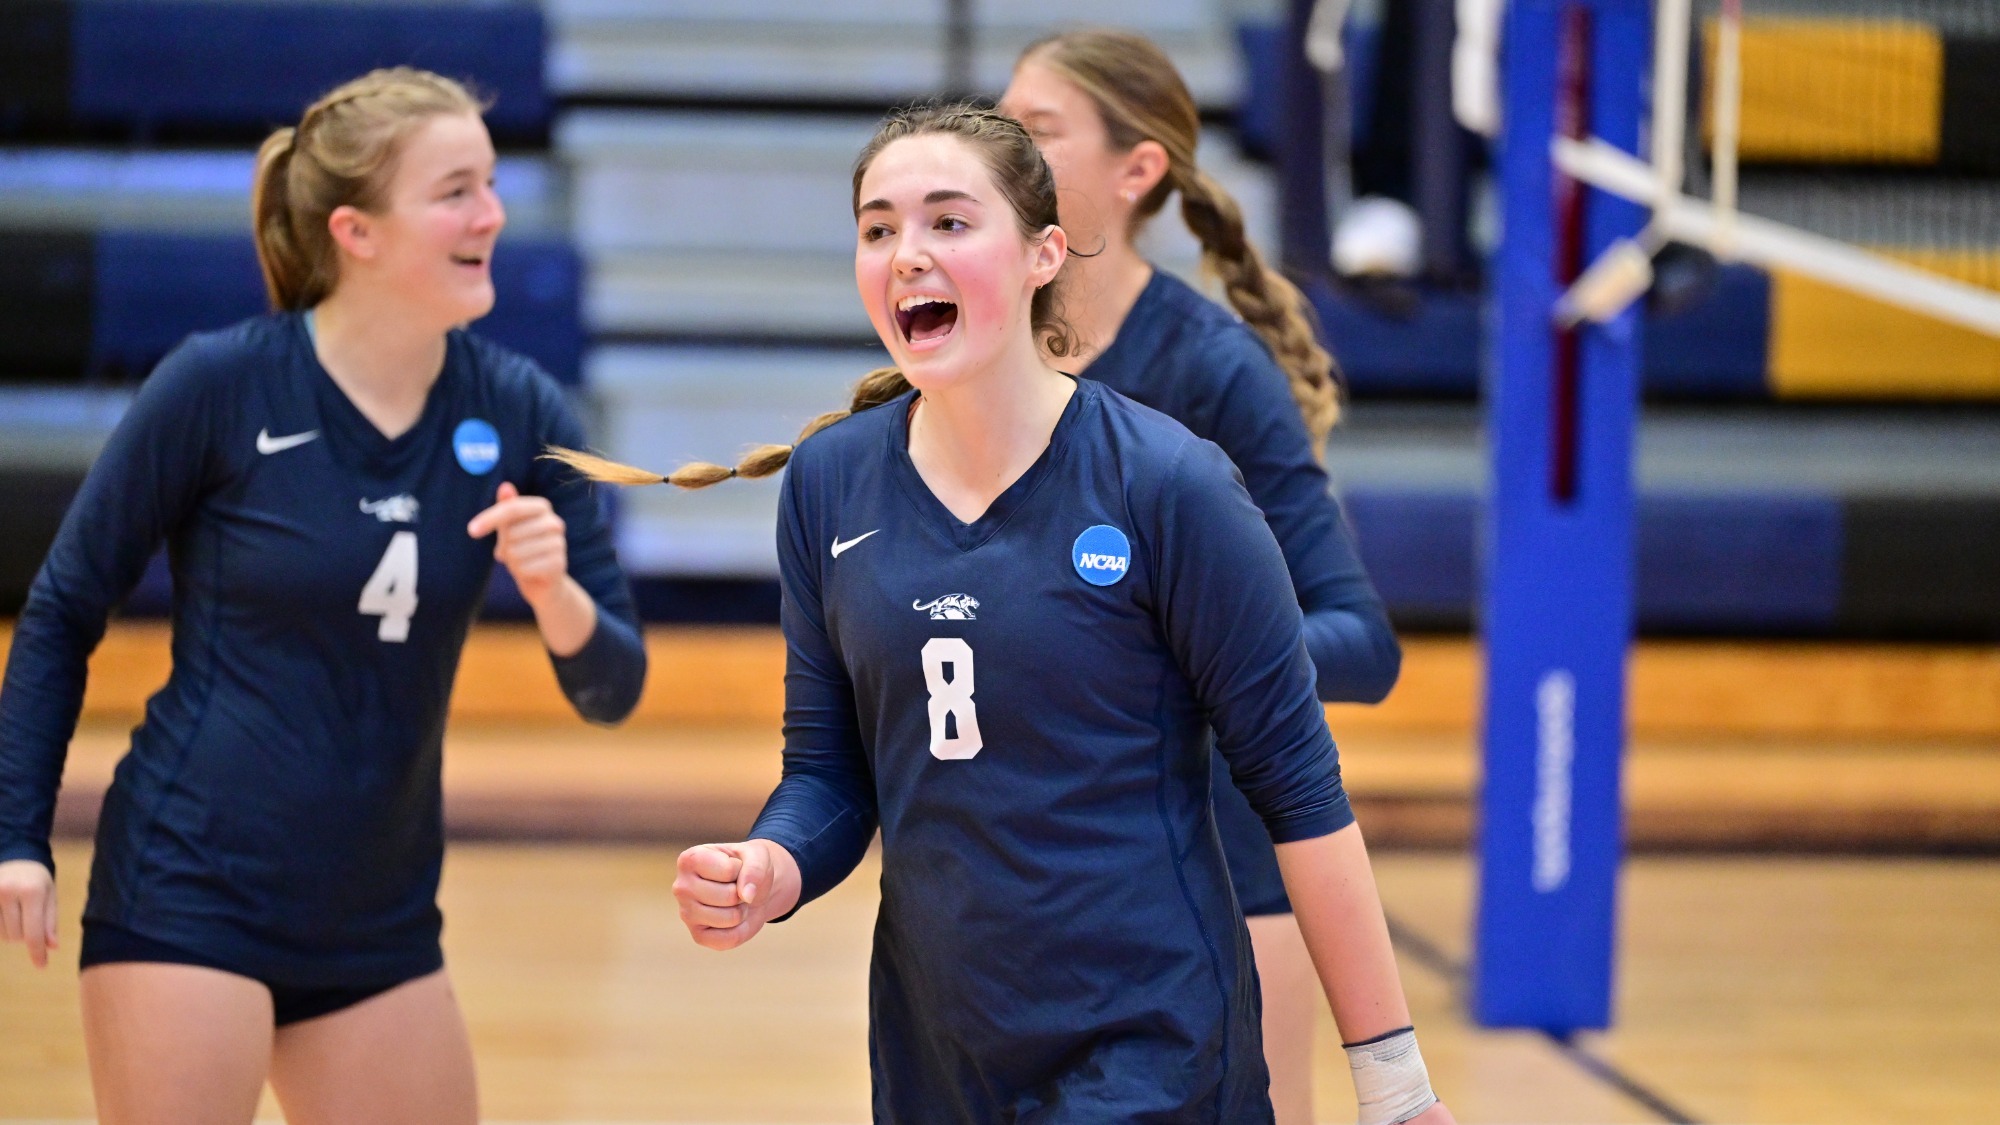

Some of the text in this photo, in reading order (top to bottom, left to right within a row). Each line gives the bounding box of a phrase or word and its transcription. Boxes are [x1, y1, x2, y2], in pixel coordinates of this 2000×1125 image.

[358, 530, 419, 642] 4
[1079, 552, 1127, 572] NCAA
[920, 637, 984, 761] 8
